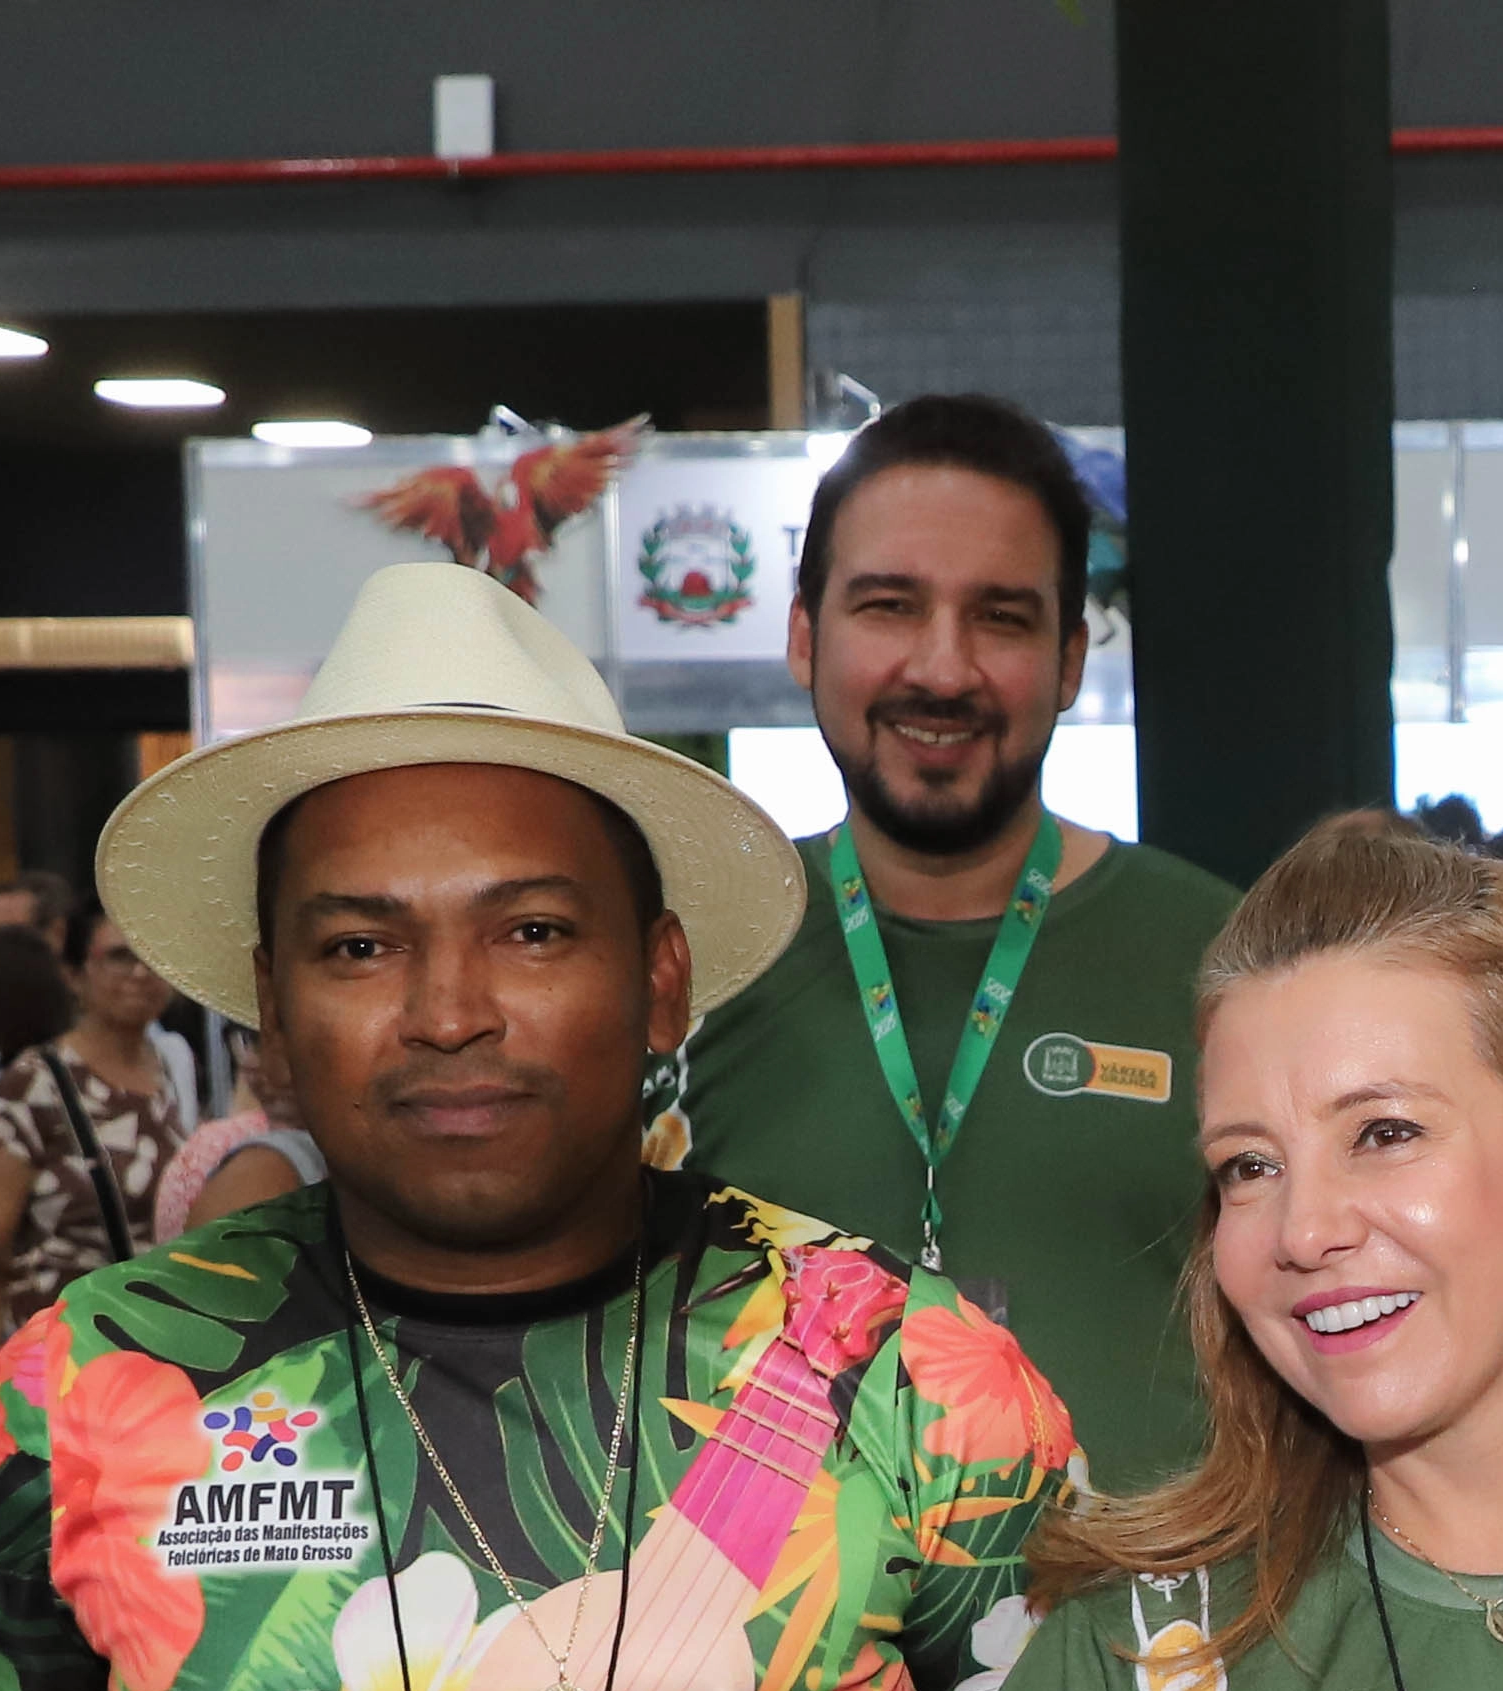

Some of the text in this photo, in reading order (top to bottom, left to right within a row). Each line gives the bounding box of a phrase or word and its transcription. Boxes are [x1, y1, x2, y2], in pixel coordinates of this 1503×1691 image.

[175, 1480, 354, 1526] AMFMT
[158, 1522, 369, 1547] Associação das Manifestações
[168, 1544, 353, 1566] Folclóricas de Mato Grosso
